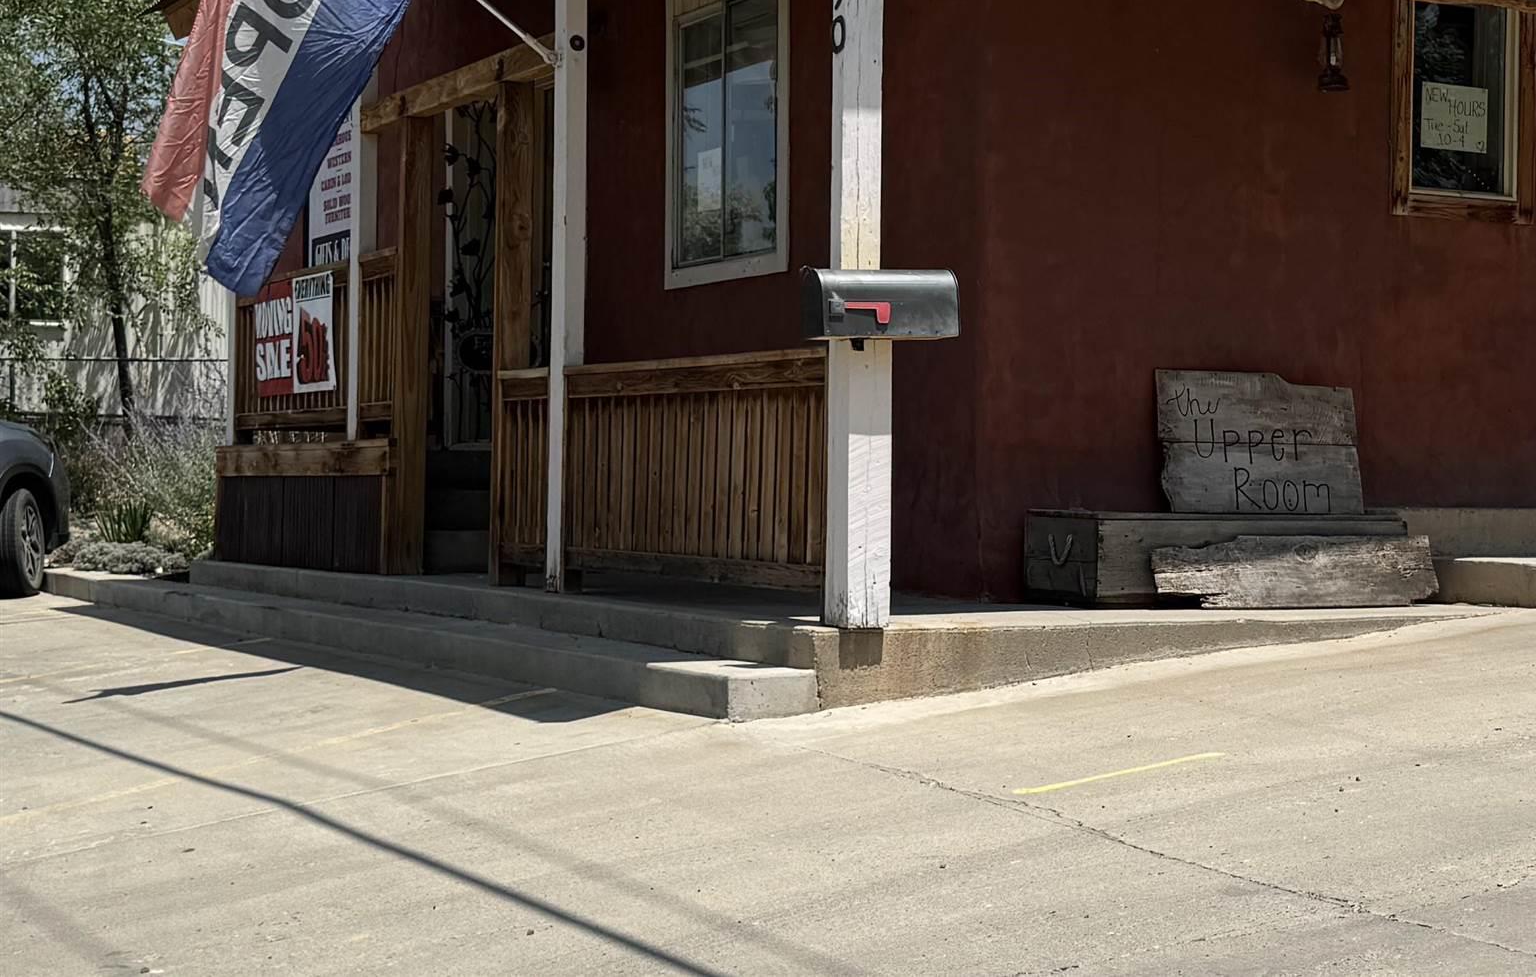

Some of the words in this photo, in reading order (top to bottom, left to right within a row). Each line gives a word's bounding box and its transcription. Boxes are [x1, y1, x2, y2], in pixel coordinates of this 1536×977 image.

[1425, 87, 1448, 102] NEW
[1448, 99, 1486, 118] HOURS
[255, 296, 292, 339] MOVING
[256, 339, 292, 382] SALE
[1193, 418, 1312, 464] Upper
[1233, 467, 1331, 512] Room
